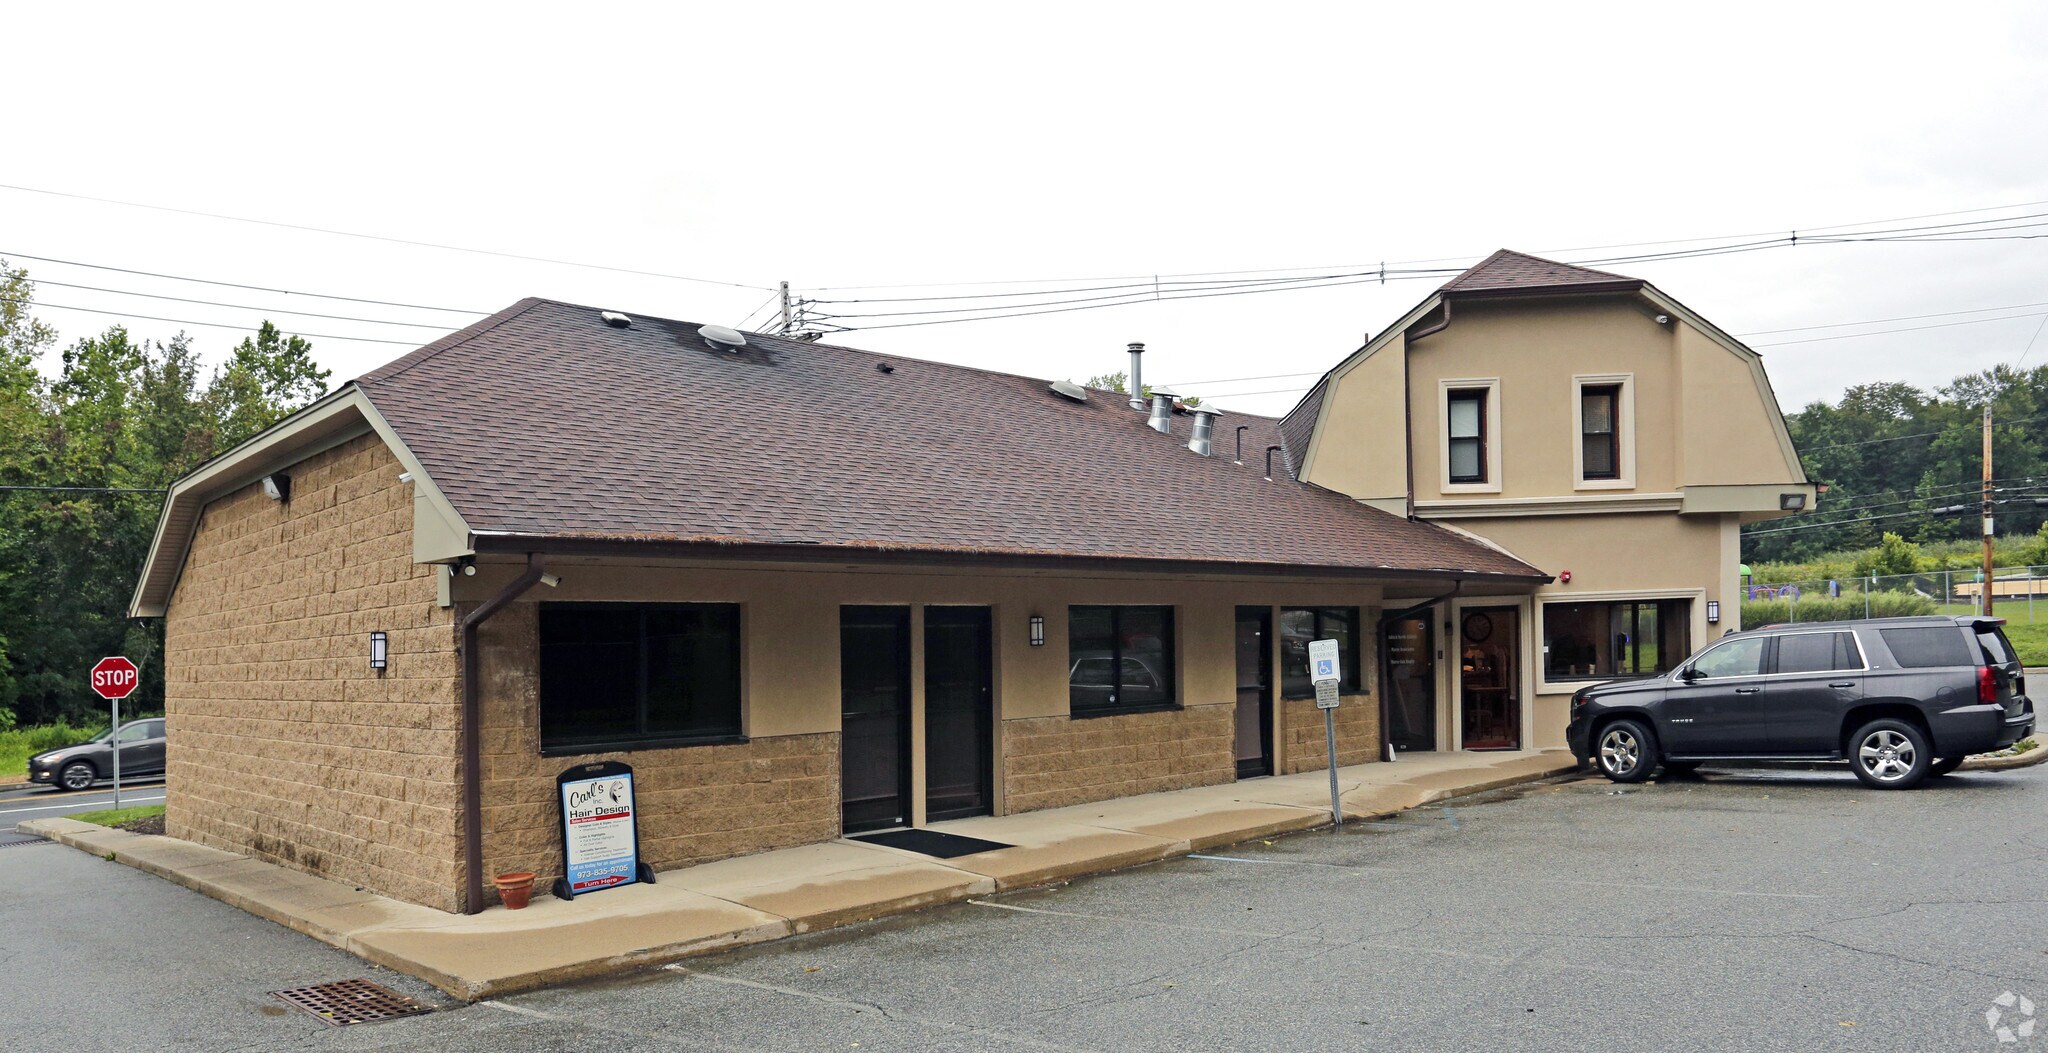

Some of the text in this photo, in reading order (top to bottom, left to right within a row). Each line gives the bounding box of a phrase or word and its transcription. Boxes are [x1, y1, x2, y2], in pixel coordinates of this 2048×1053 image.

[95, 669, 135, 686] STOP
[570, 781, 604, 808] Carl's
[569, 805, 630, 818] Hair Design
[577, 864, 628, 879] 973-835-9705
